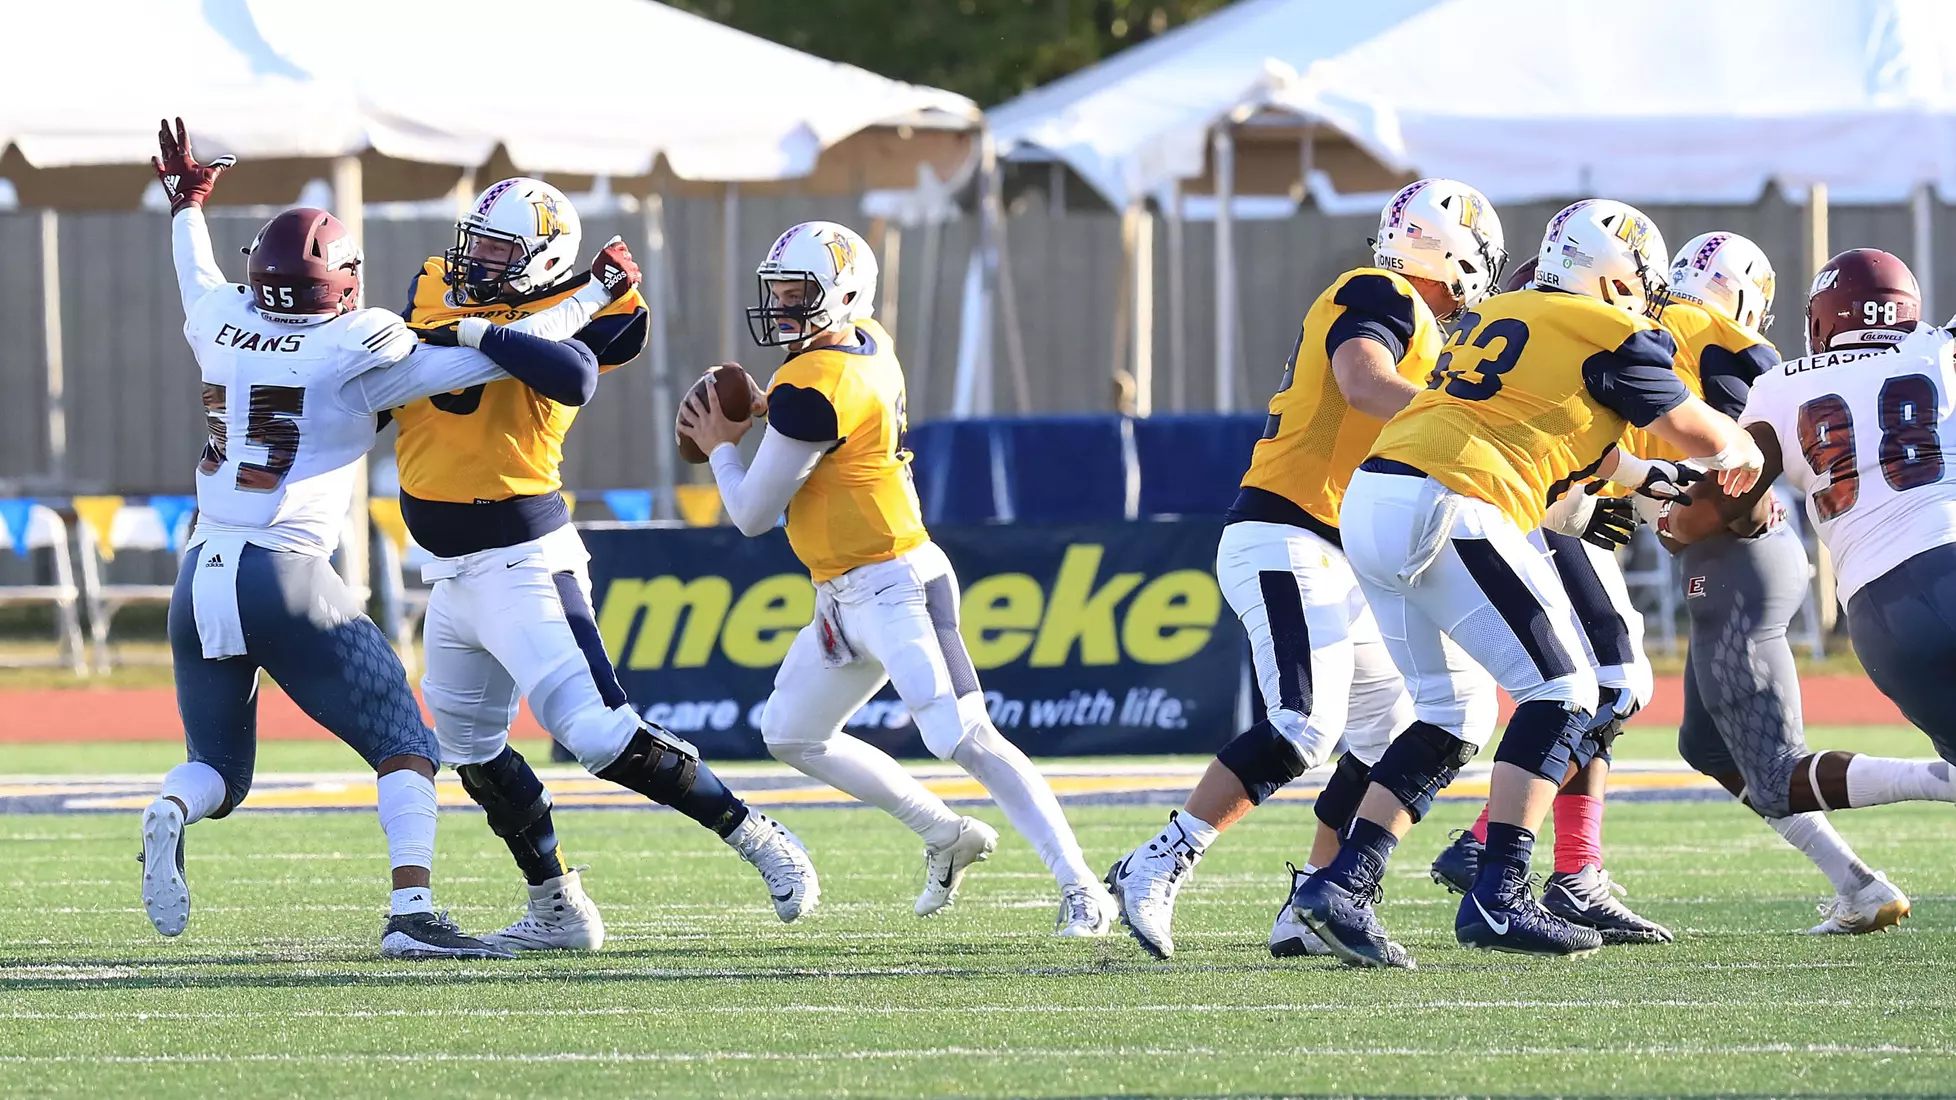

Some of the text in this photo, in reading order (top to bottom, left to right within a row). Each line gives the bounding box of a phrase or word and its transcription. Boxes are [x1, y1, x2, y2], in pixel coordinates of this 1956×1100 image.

[262, 285, 294, 308] 55
[214, 323, 306, 352] EVANS
[1796, 373, 1946, 525] 98
[1029, 689, 1115, 729] with
[1119, 686, 1189, 730] life.
